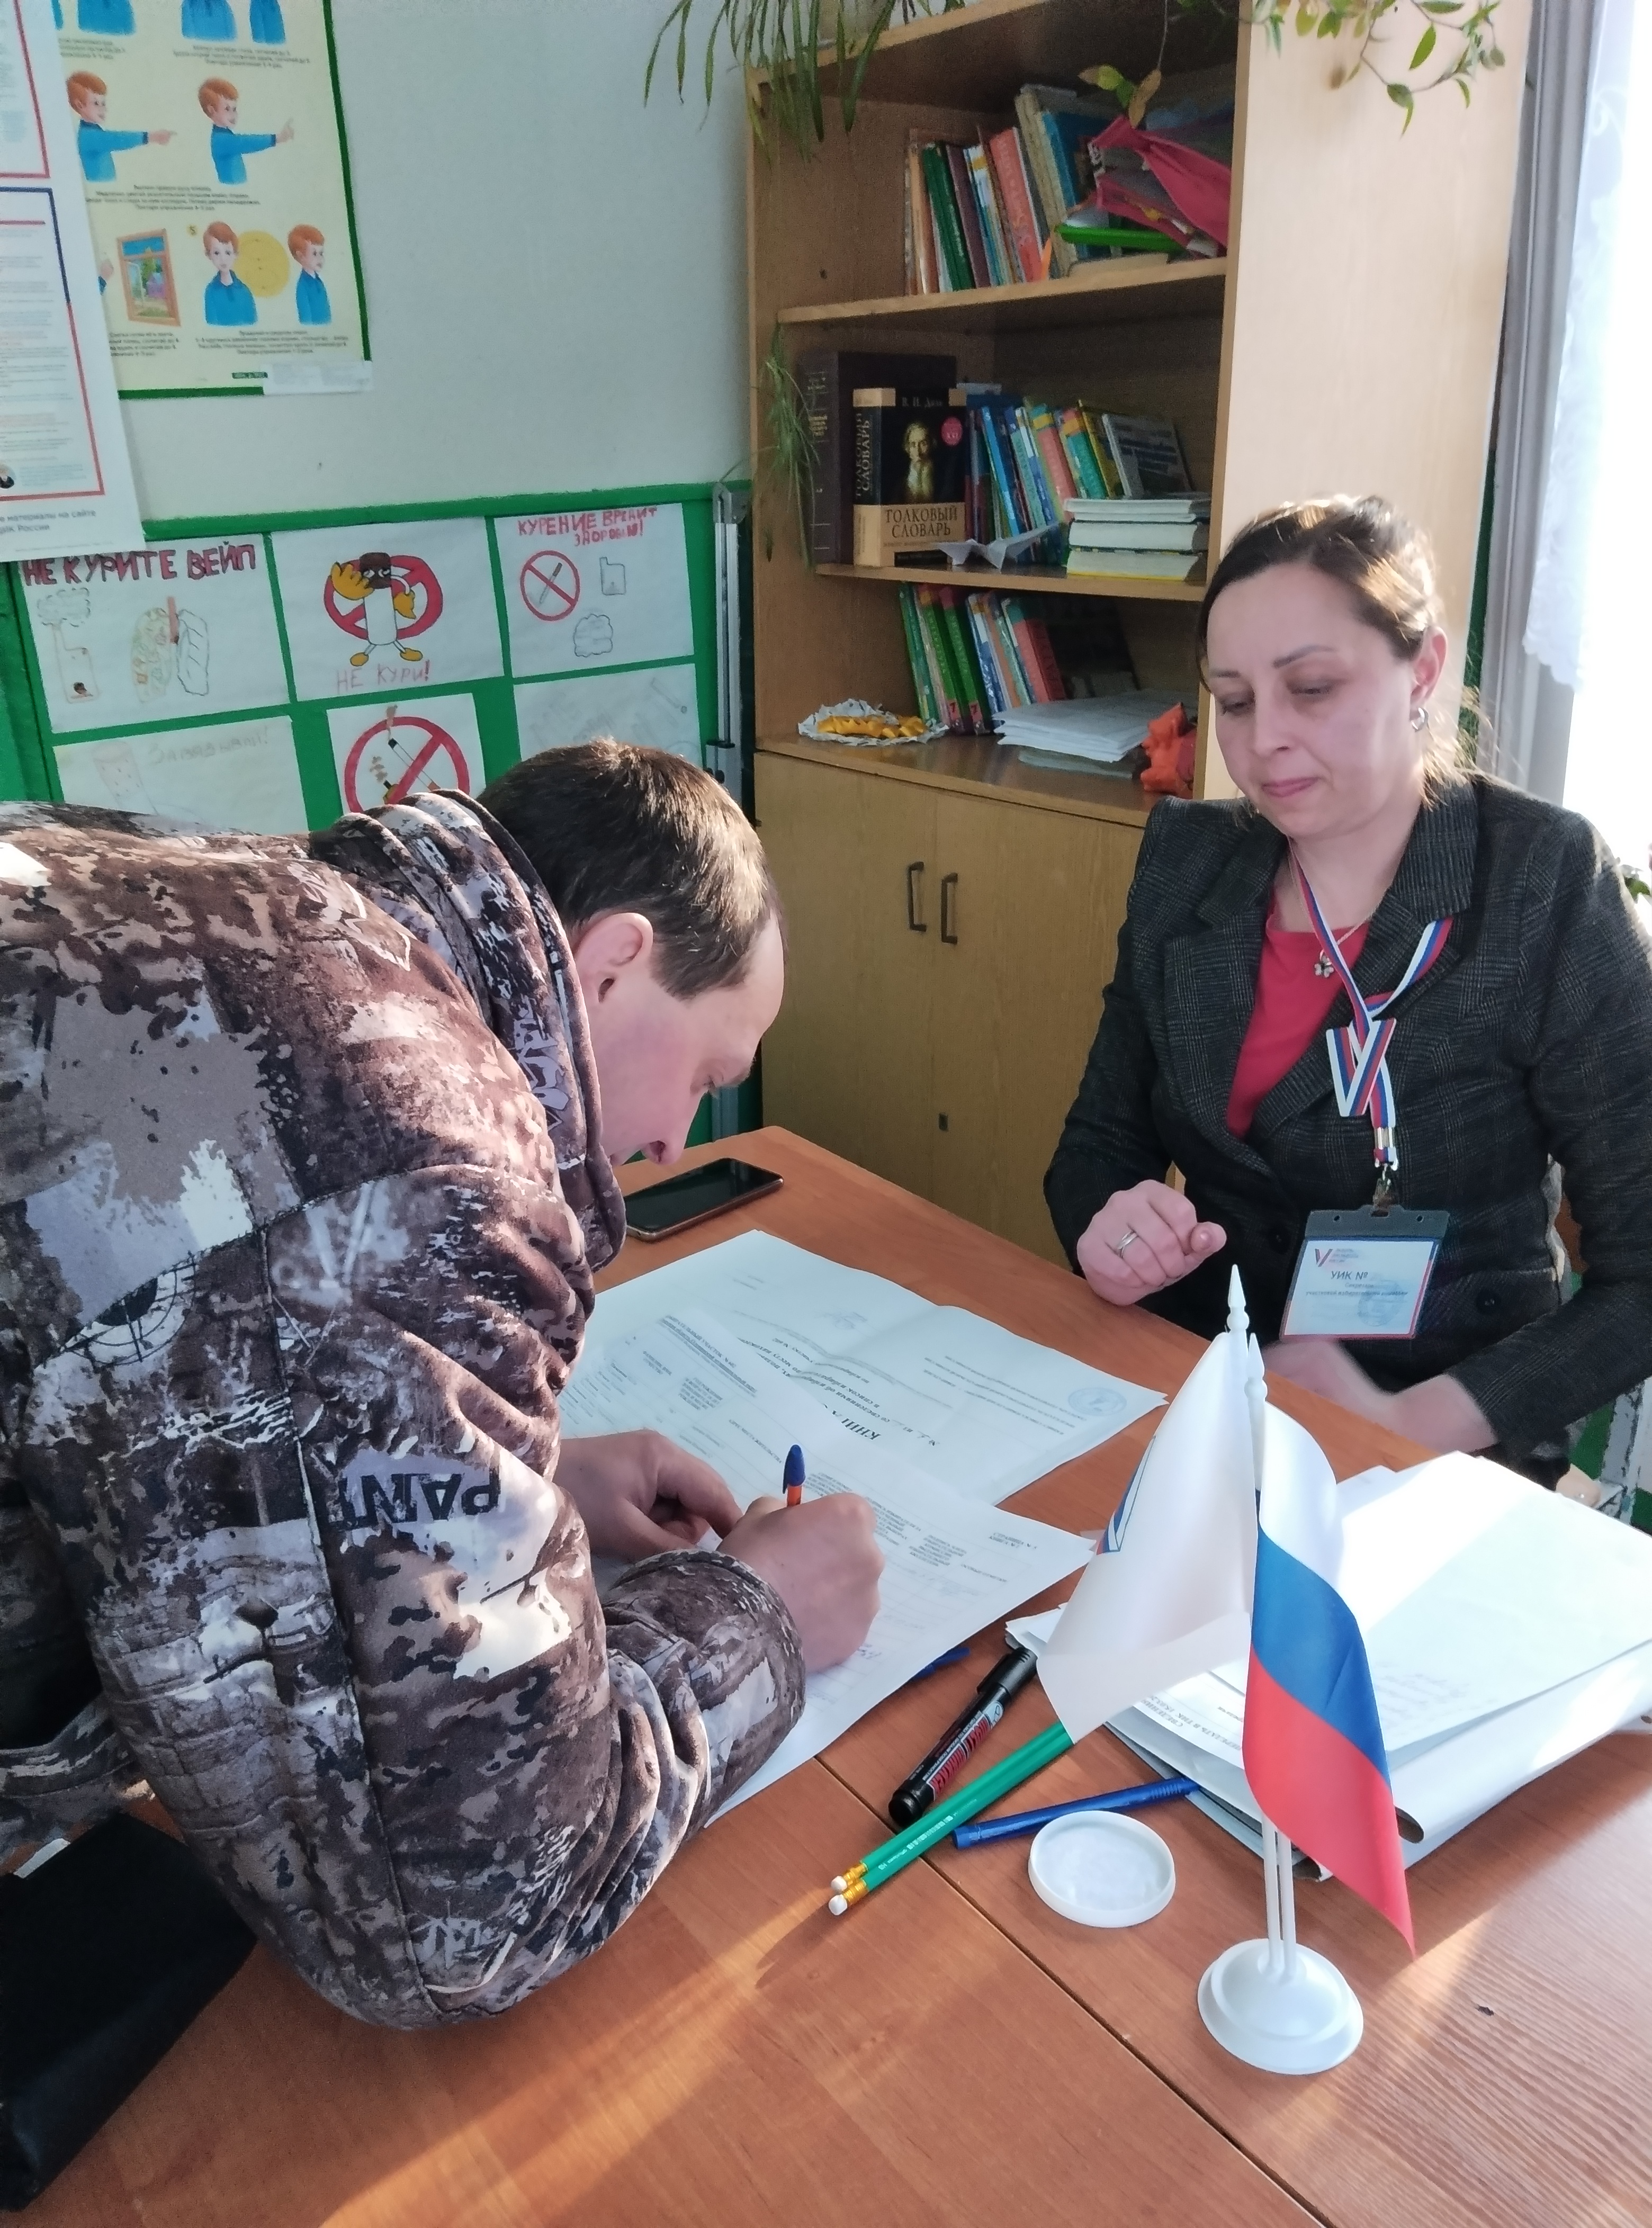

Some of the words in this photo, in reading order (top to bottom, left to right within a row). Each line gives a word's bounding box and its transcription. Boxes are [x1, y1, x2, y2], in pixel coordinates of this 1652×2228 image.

[861, 420, 870, 491] СЛОВАРЬ
[518, 512, 597, 536] КУРЕНИЕ
[602, 507, 657, 527] ВРЕДИТ
[886, 506, 958, 523] ТОЛКОВЫЙ
[892, 522, 951, 538] СЛОВАРЬ
[21, 558, 57, 586] НЕ
[64, 550, 177, 583] КУРИТЕ
[186, 541, 256, 580] ВЕЙП
[337, 668, 363, 695] НЕ
[377, 659, 429, 685] КУРИ!
[1331, 1271, 1353, 1280] УИК
[1355, 1271, 1369, 1280] №
